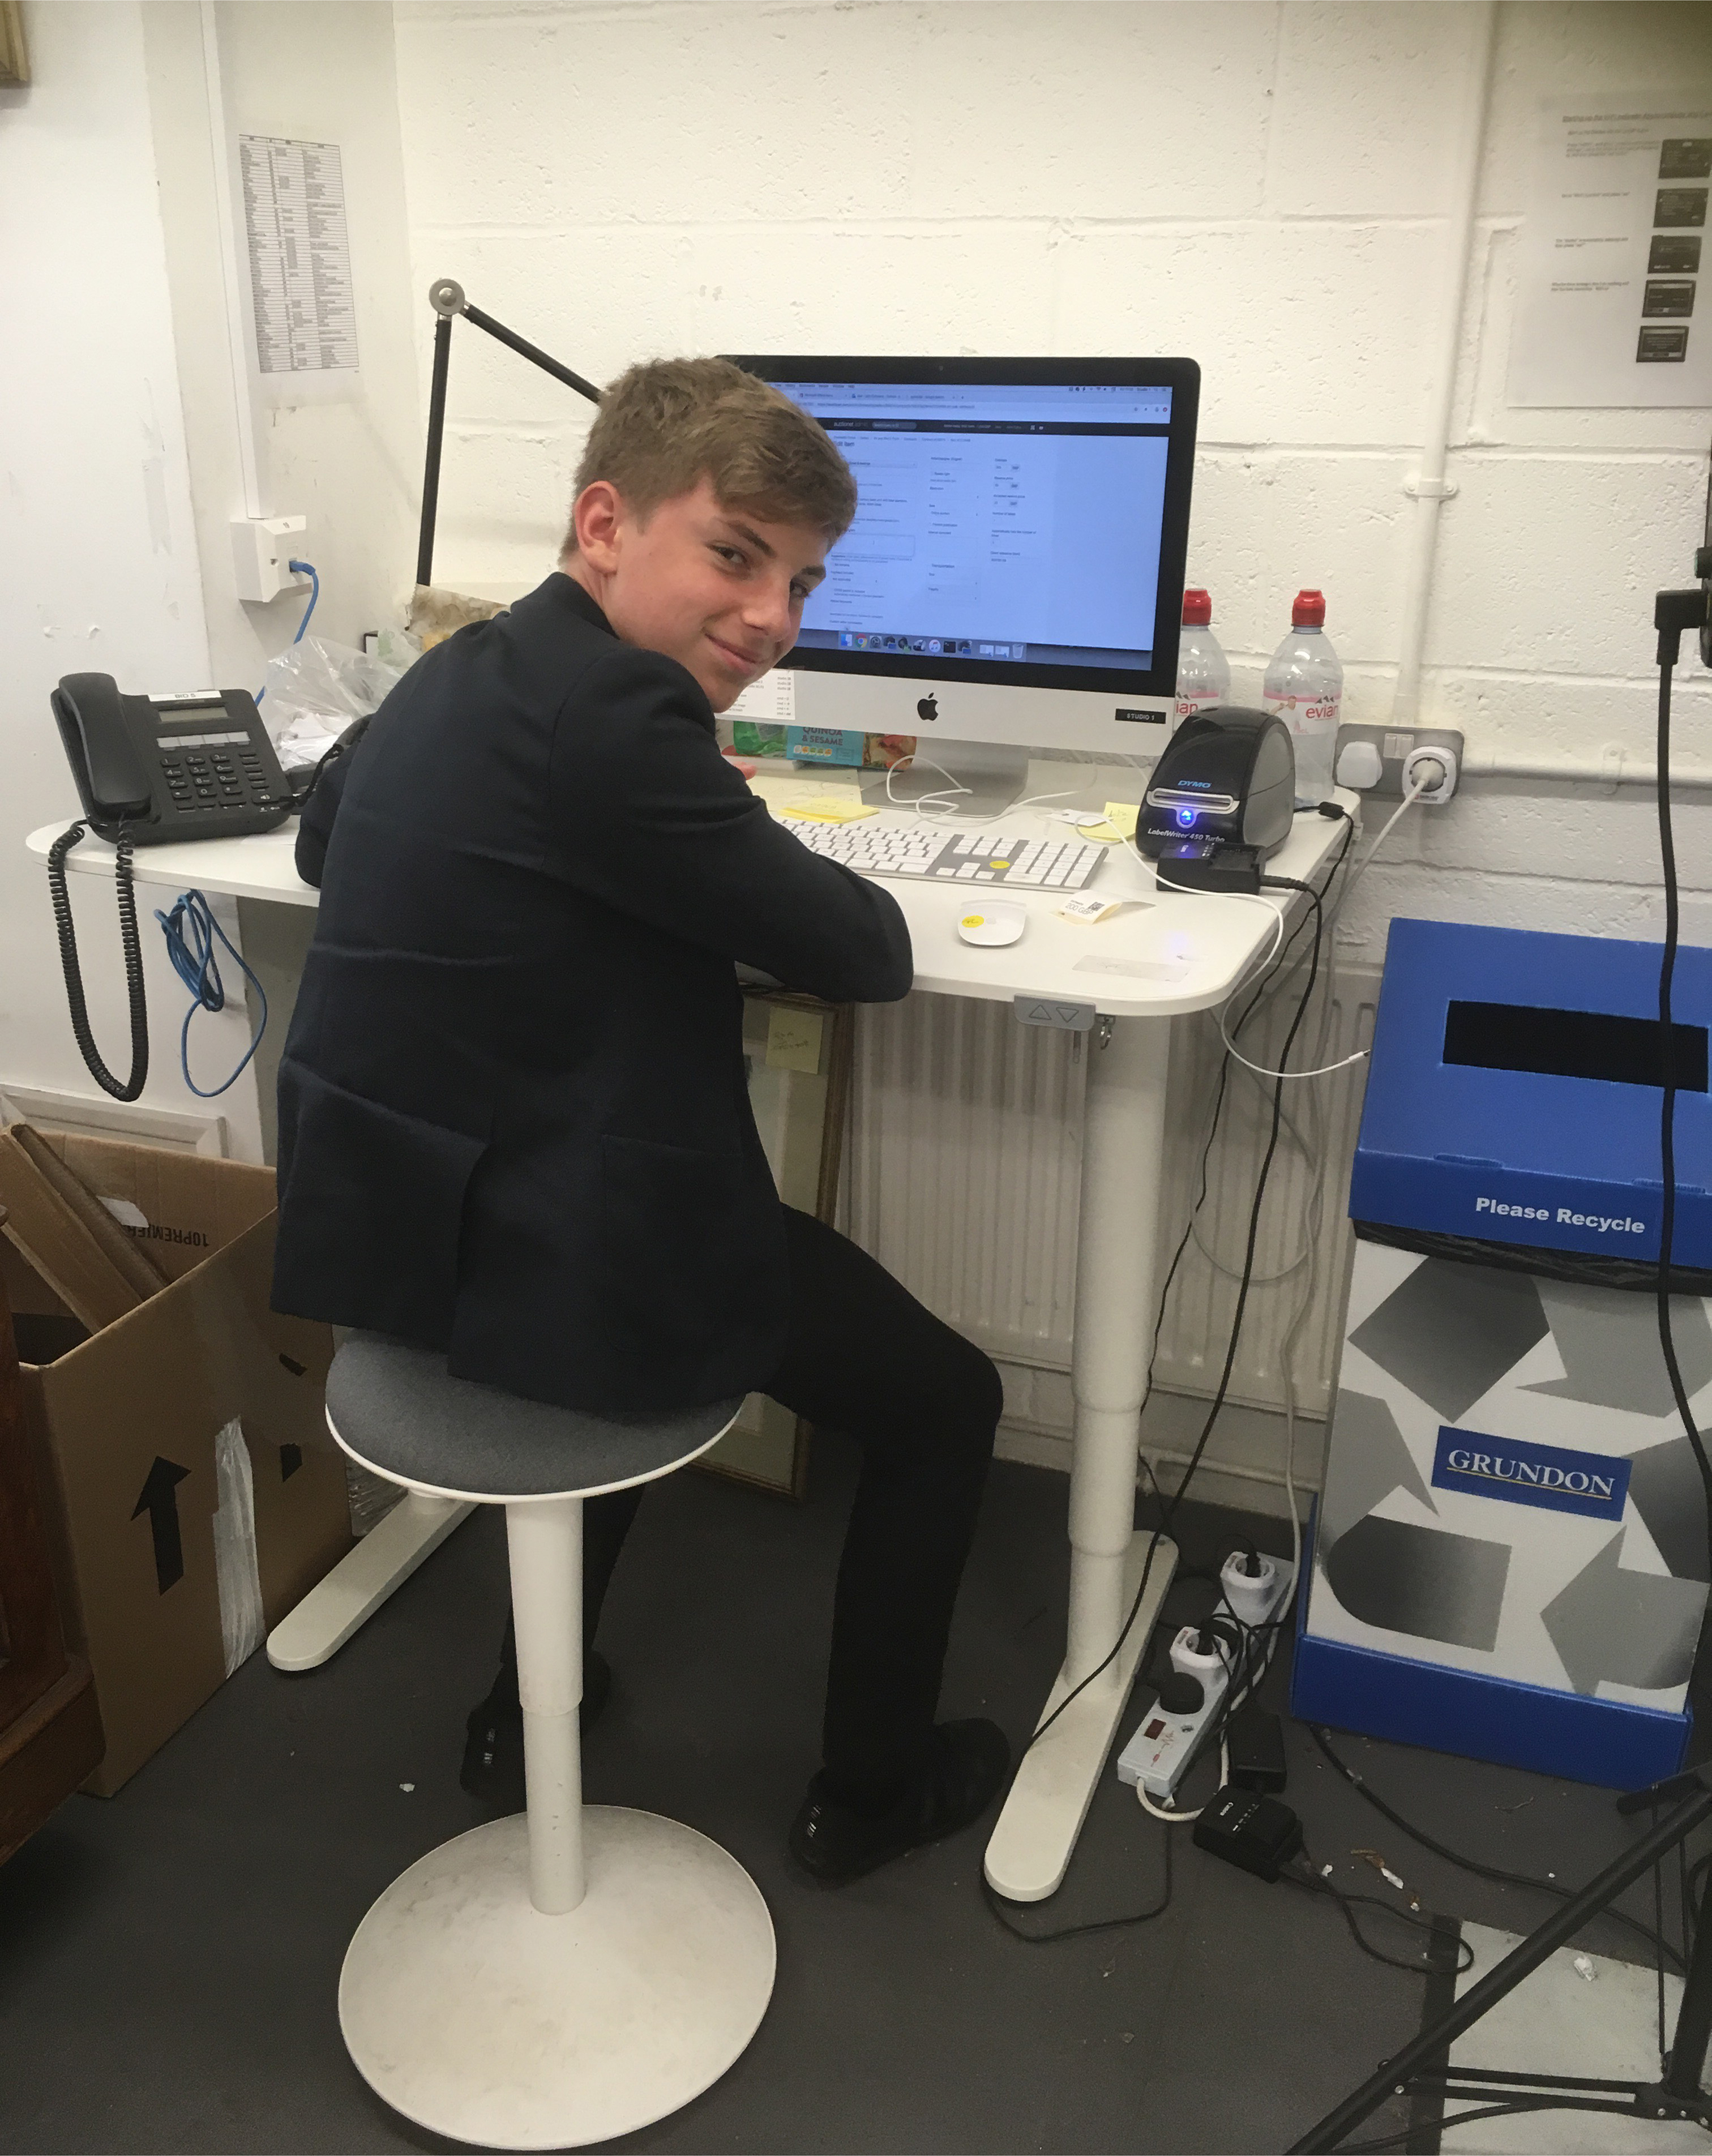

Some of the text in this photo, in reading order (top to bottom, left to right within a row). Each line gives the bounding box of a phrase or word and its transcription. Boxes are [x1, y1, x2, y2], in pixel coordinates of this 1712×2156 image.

[1176, 700, 1198, 713] ian
[1306, 704, 1338, 719] evian
[803, 726, 843, 737] QUINOA
[810, 735, 844, 746] SESAME
[1148, 828, 1190, 839] LabelWriter
[1065, 902, 1077, 912] 200
[1475, 1197, 1645, 1233] Please Recycle
[1448, 1449, 1616, 1496] GRUNDON
